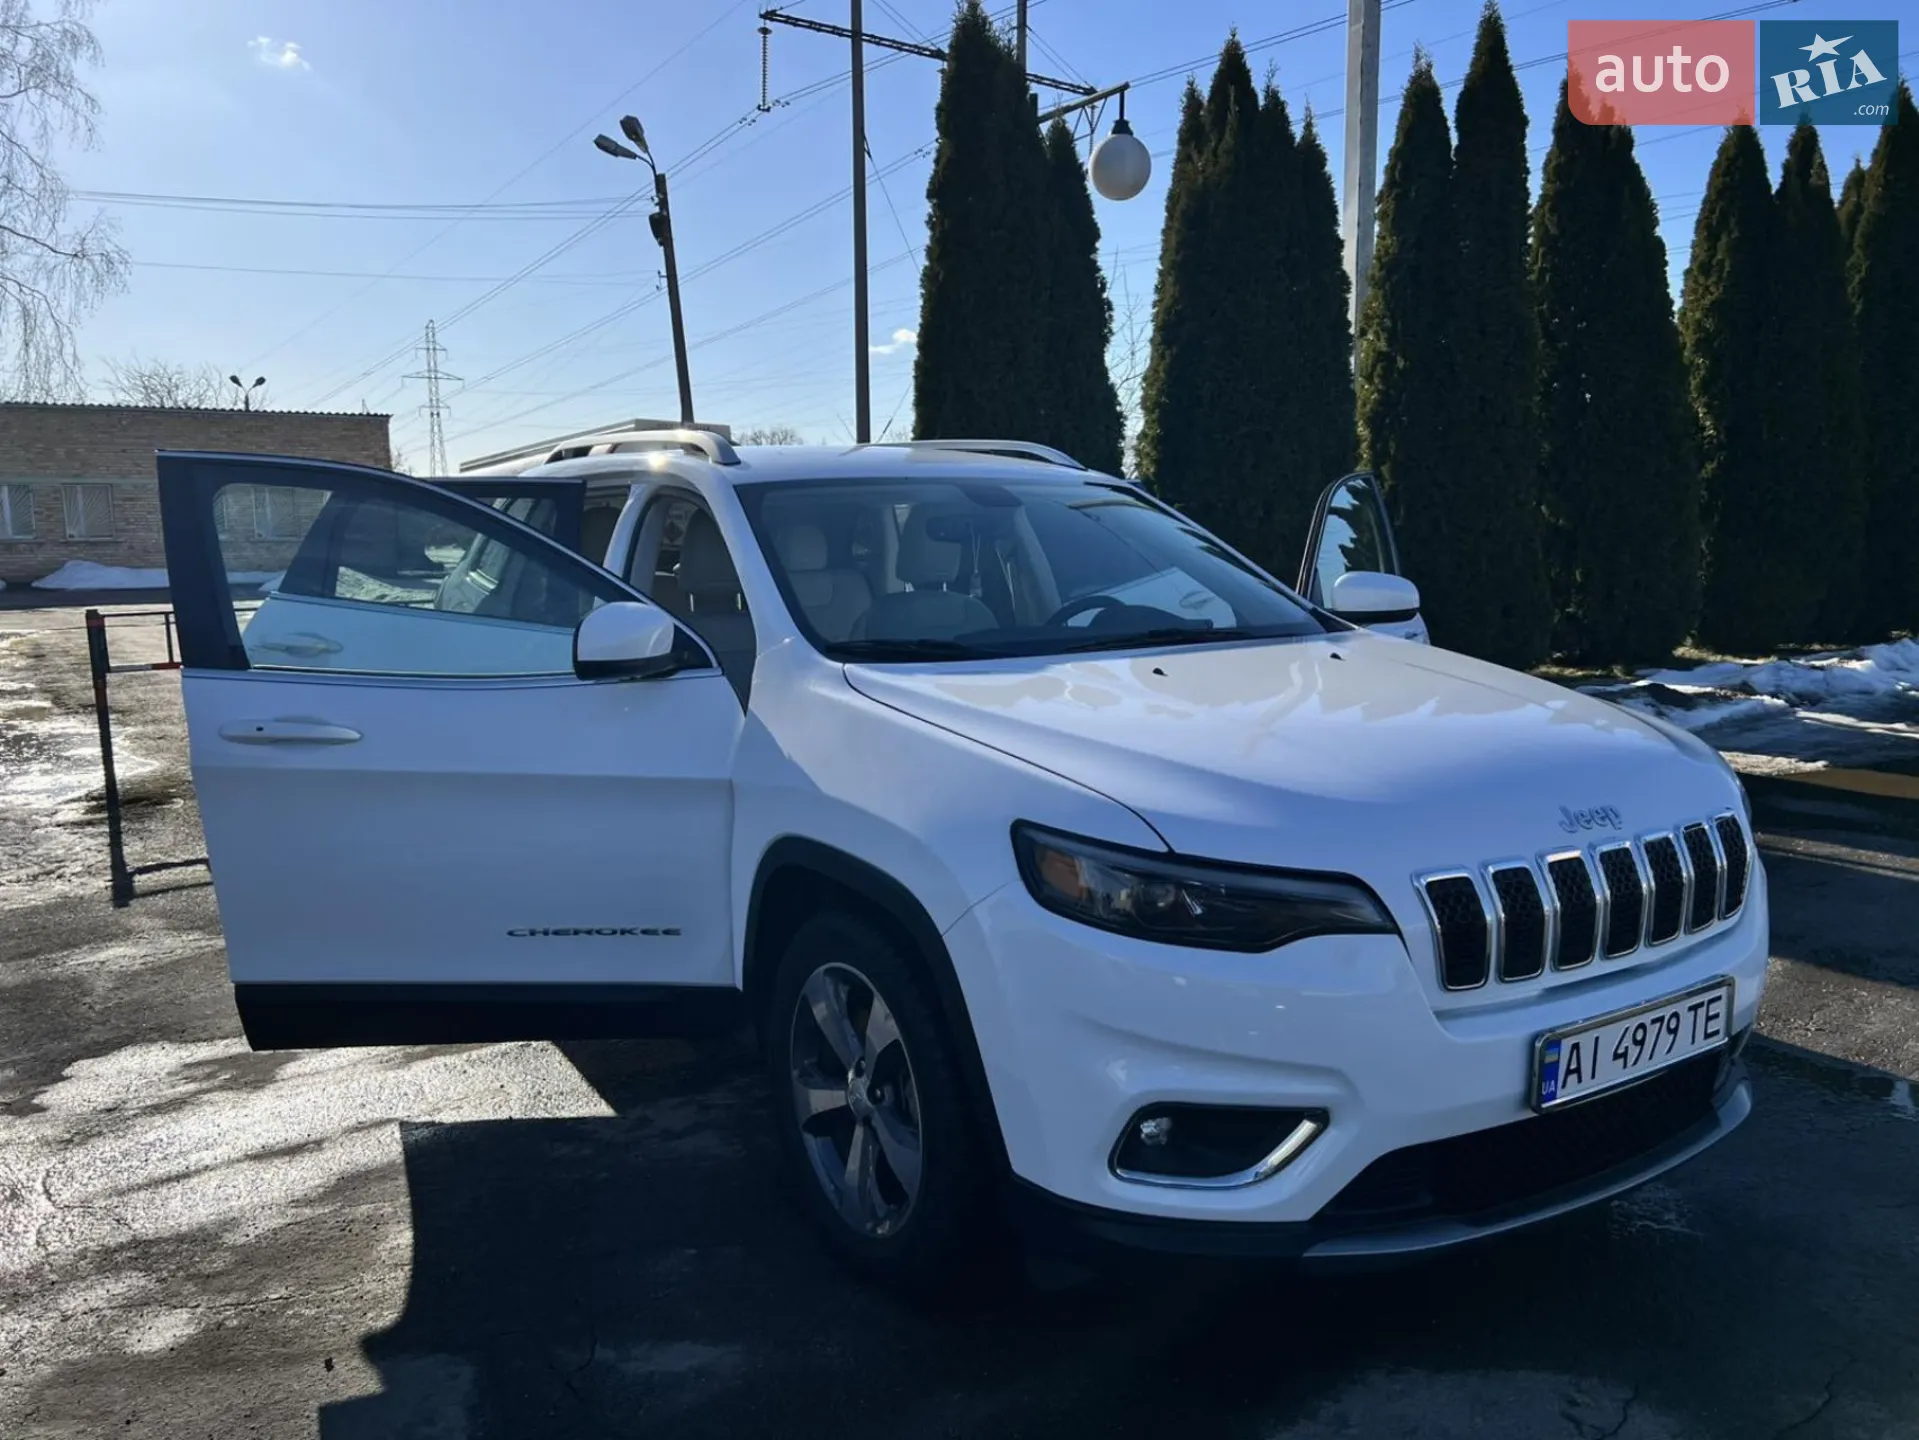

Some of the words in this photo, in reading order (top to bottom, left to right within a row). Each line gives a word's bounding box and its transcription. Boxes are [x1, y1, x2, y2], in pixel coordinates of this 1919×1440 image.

[1558, 804, 1623, 834] Jeep
[506, 926, 682, 938] CHEROKEE
[1561, 1035, 1600, 1089] AI
[1612, 1009, 1681, 1070] 4979
[1687, 995, 1723, 1046] TE
[1541, 1084, 1556, 1097] UA
